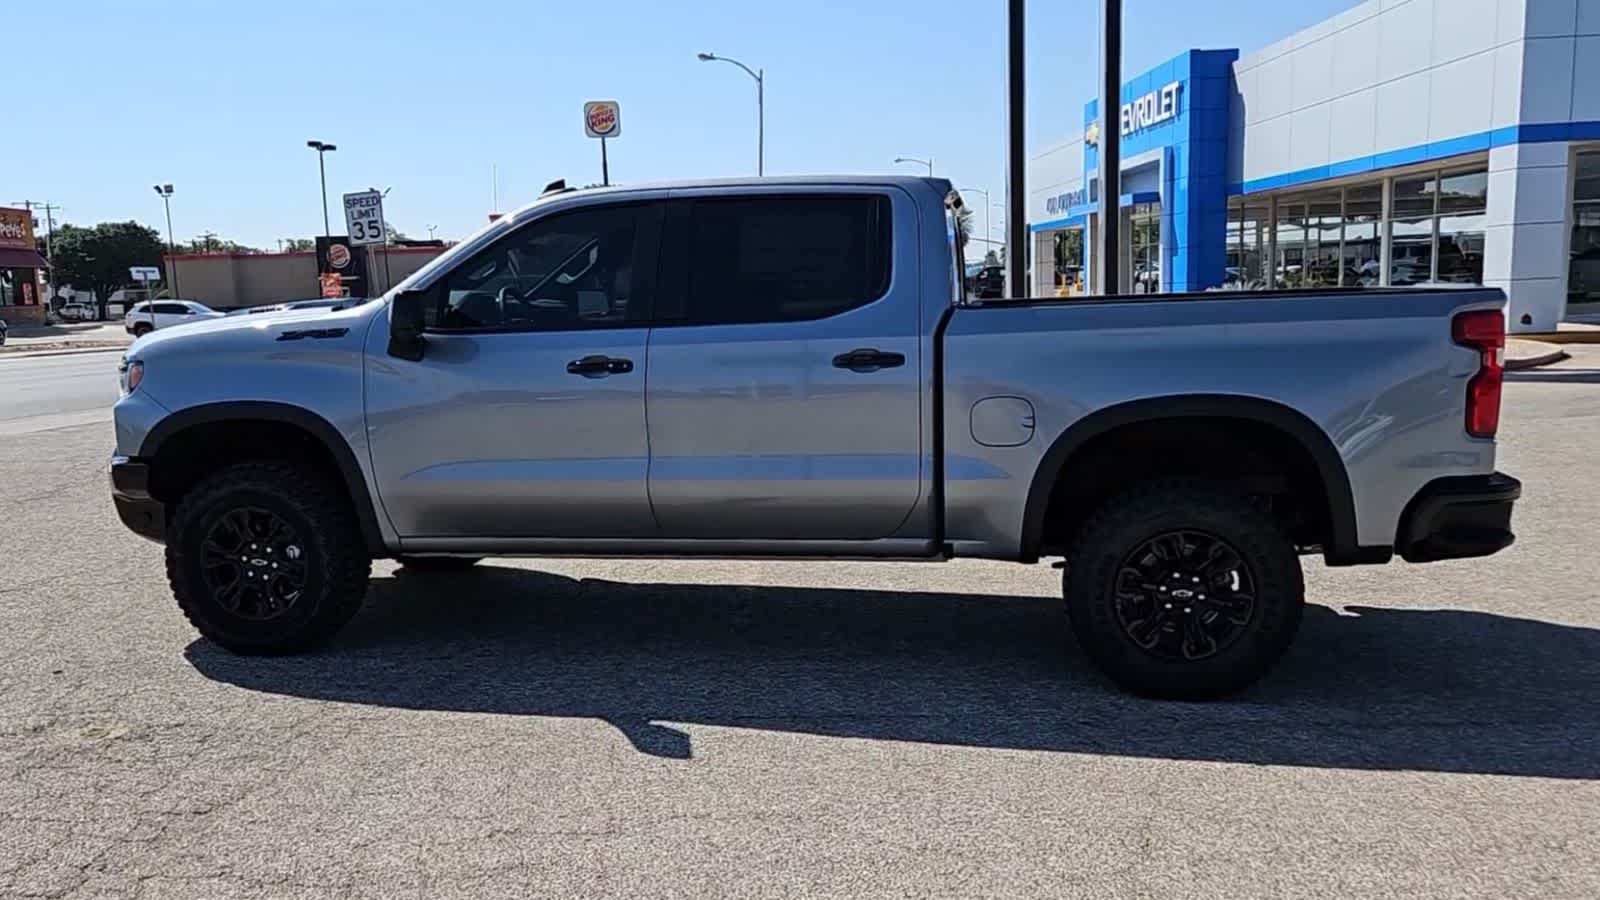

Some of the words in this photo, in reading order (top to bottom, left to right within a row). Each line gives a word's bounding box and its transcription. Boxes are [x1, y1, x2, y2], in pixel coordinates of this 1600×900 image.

[1121, 80, 1179, 136] EVROLET
[591, 114, 615, 128] KING
[345, 196, 379, 209] SPEED
[351, 208, 376, 220] LIMIT
[353, 220, 381, 240] 35
